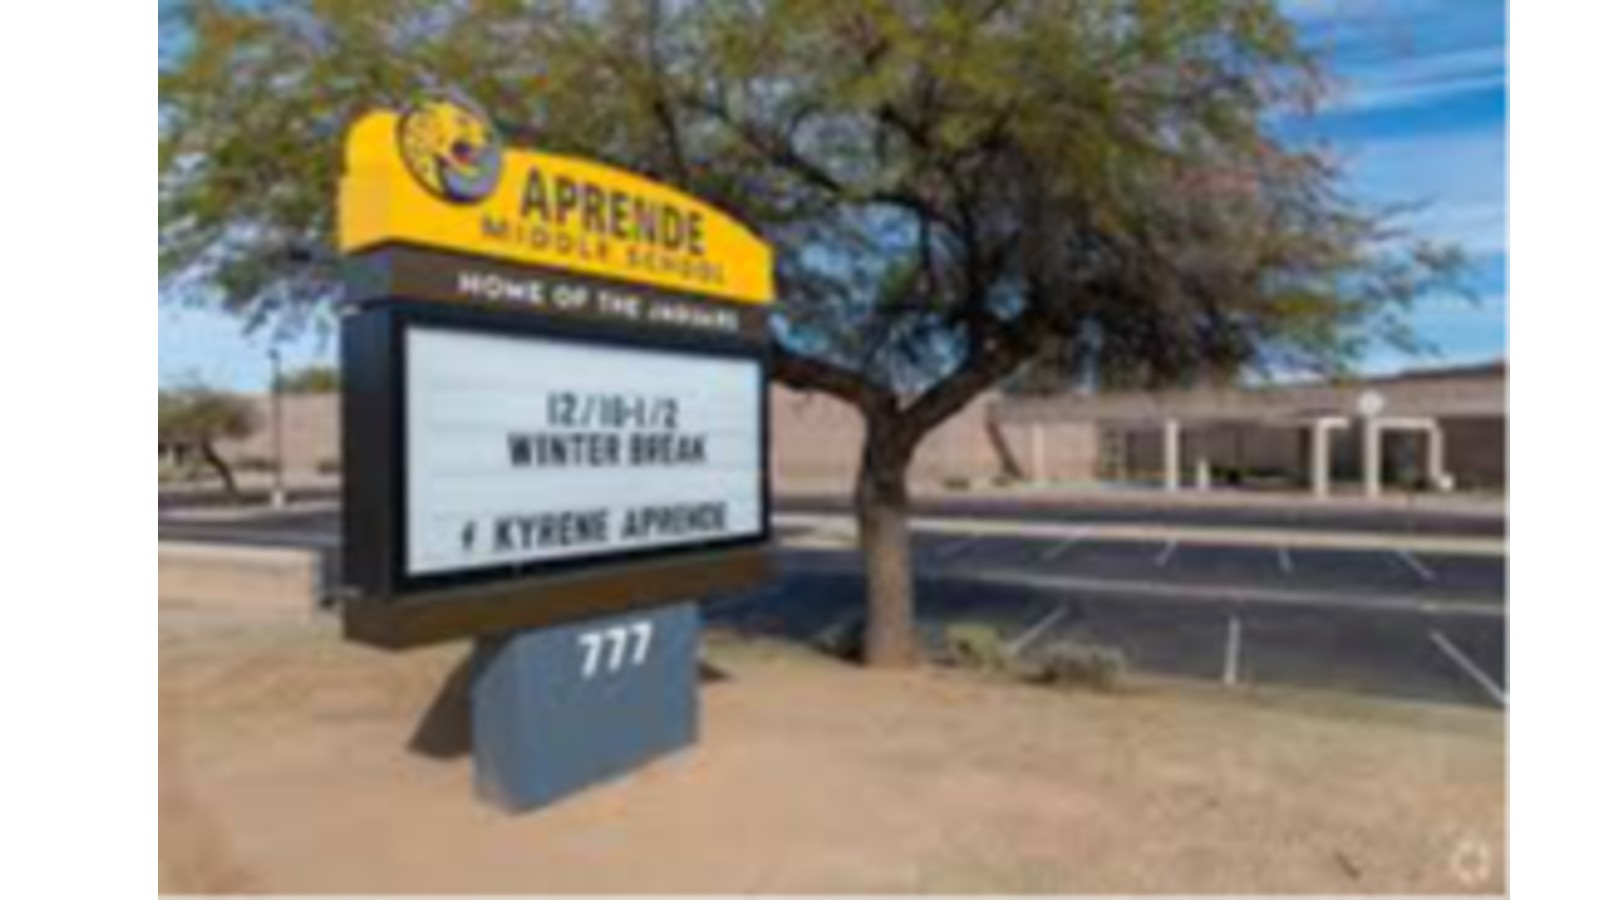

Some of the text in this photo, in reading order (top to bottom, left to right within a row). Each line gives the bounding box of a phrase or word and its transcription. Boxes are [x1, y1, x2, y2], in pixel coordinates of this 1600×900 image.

[519, 167, 706, 256] APRENDE
[481, 215, 727, 285] MIDDLE SCHOOL
[458, 273, 543, 305] HOME
[551, 285, 588, 308] OF
[598, 291, 640, 319] THE
[507, 432, 706, 467] WINTER BREAK
[494, 510, 609, 550] KYRENE
[620, 501, 728, 541] APRENDE
[579, 621, 652, 678] 777
